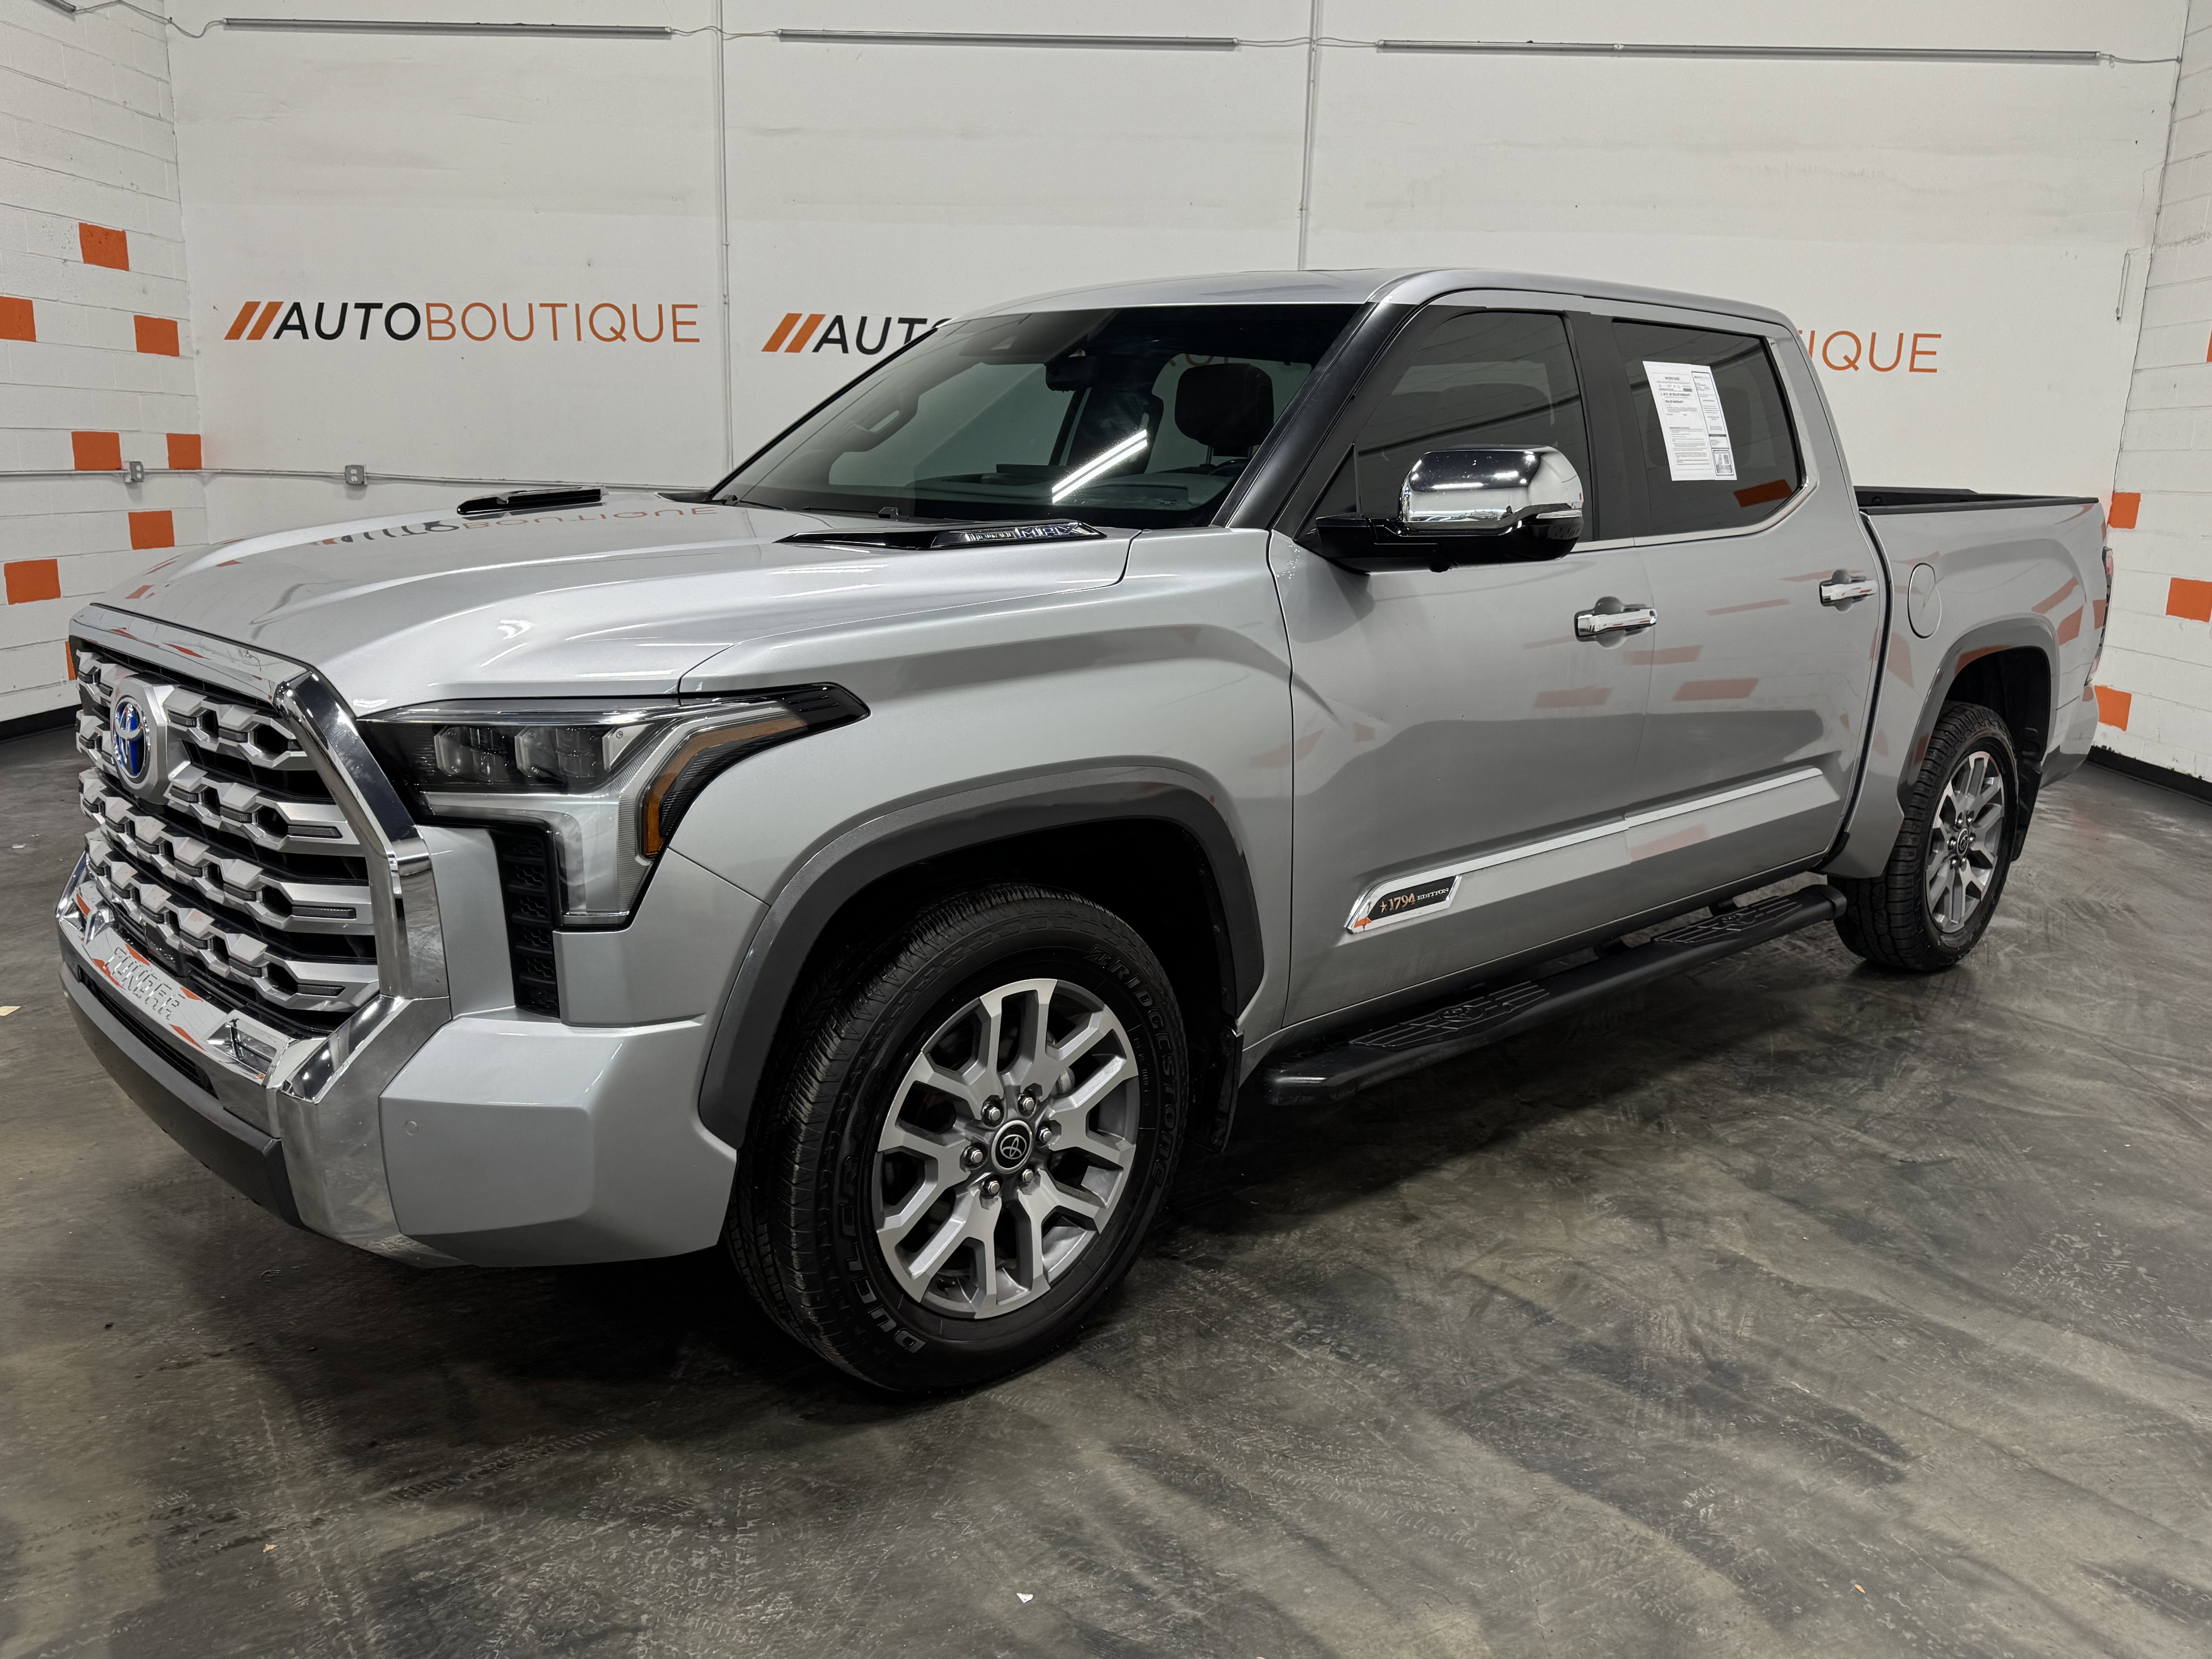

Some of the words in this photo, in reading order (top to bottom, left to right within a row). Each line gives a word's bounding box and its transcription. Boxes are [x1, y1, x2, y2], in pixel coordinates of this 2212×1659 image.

[273, 302, 699, 342] AUTOBOUTIQUE
[1798, 330, 1941, 373] IQUE
[1388, 893, 1416, 910] 1794
[1417, 888, 1449, 900] EDITION
[1084, 944, 1176, 1188] BRIDGESTONE
